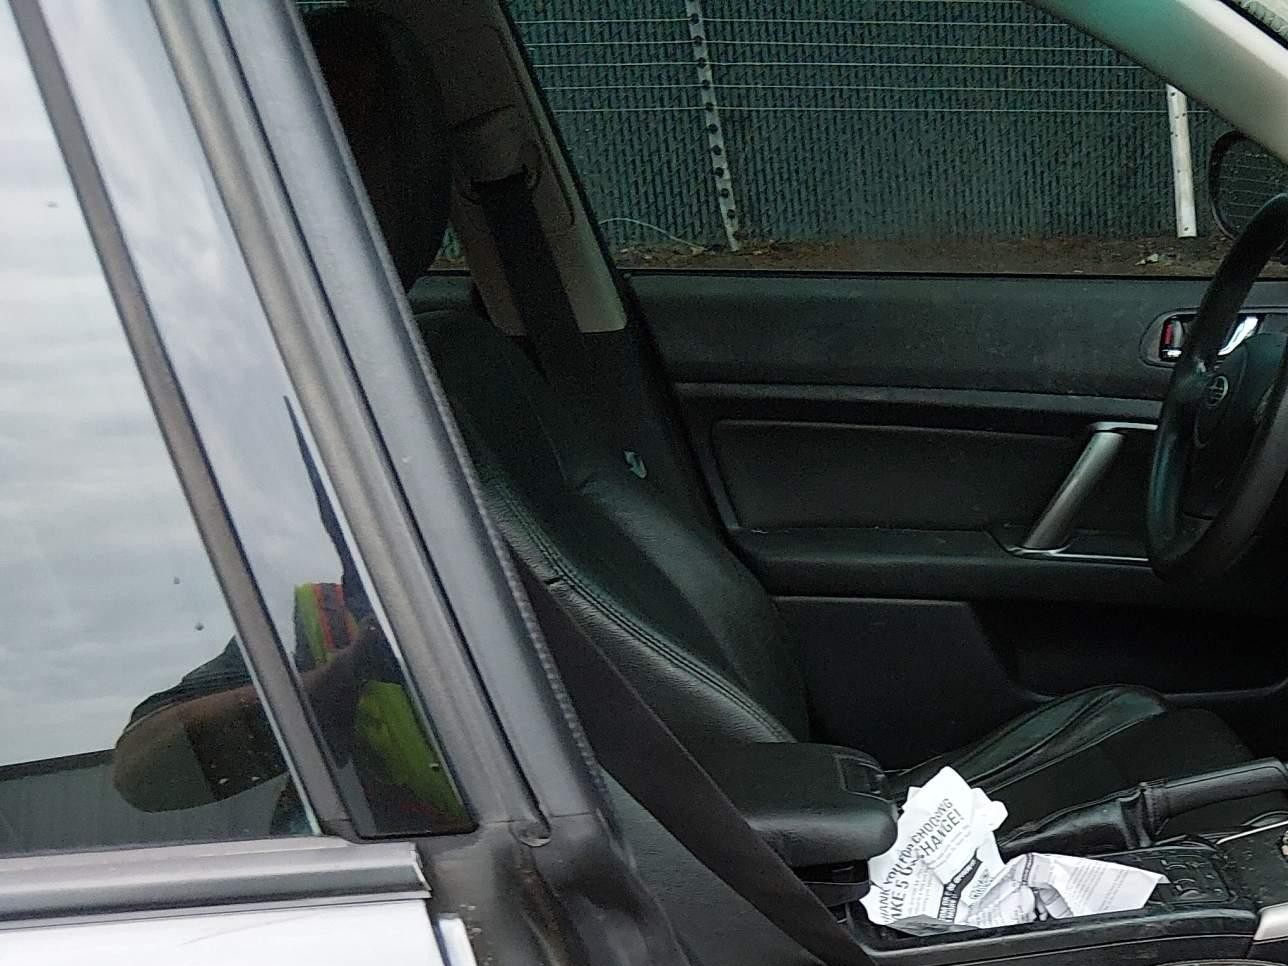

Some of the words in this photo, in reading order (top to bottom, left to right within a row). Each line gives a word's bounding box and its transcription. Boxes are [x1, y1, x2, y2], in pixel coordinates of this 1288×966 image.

[891, 891, 904, 919] AKE
[916, 808, 964, 859] HANGE!
[880, 888, 891, 922] HANK
